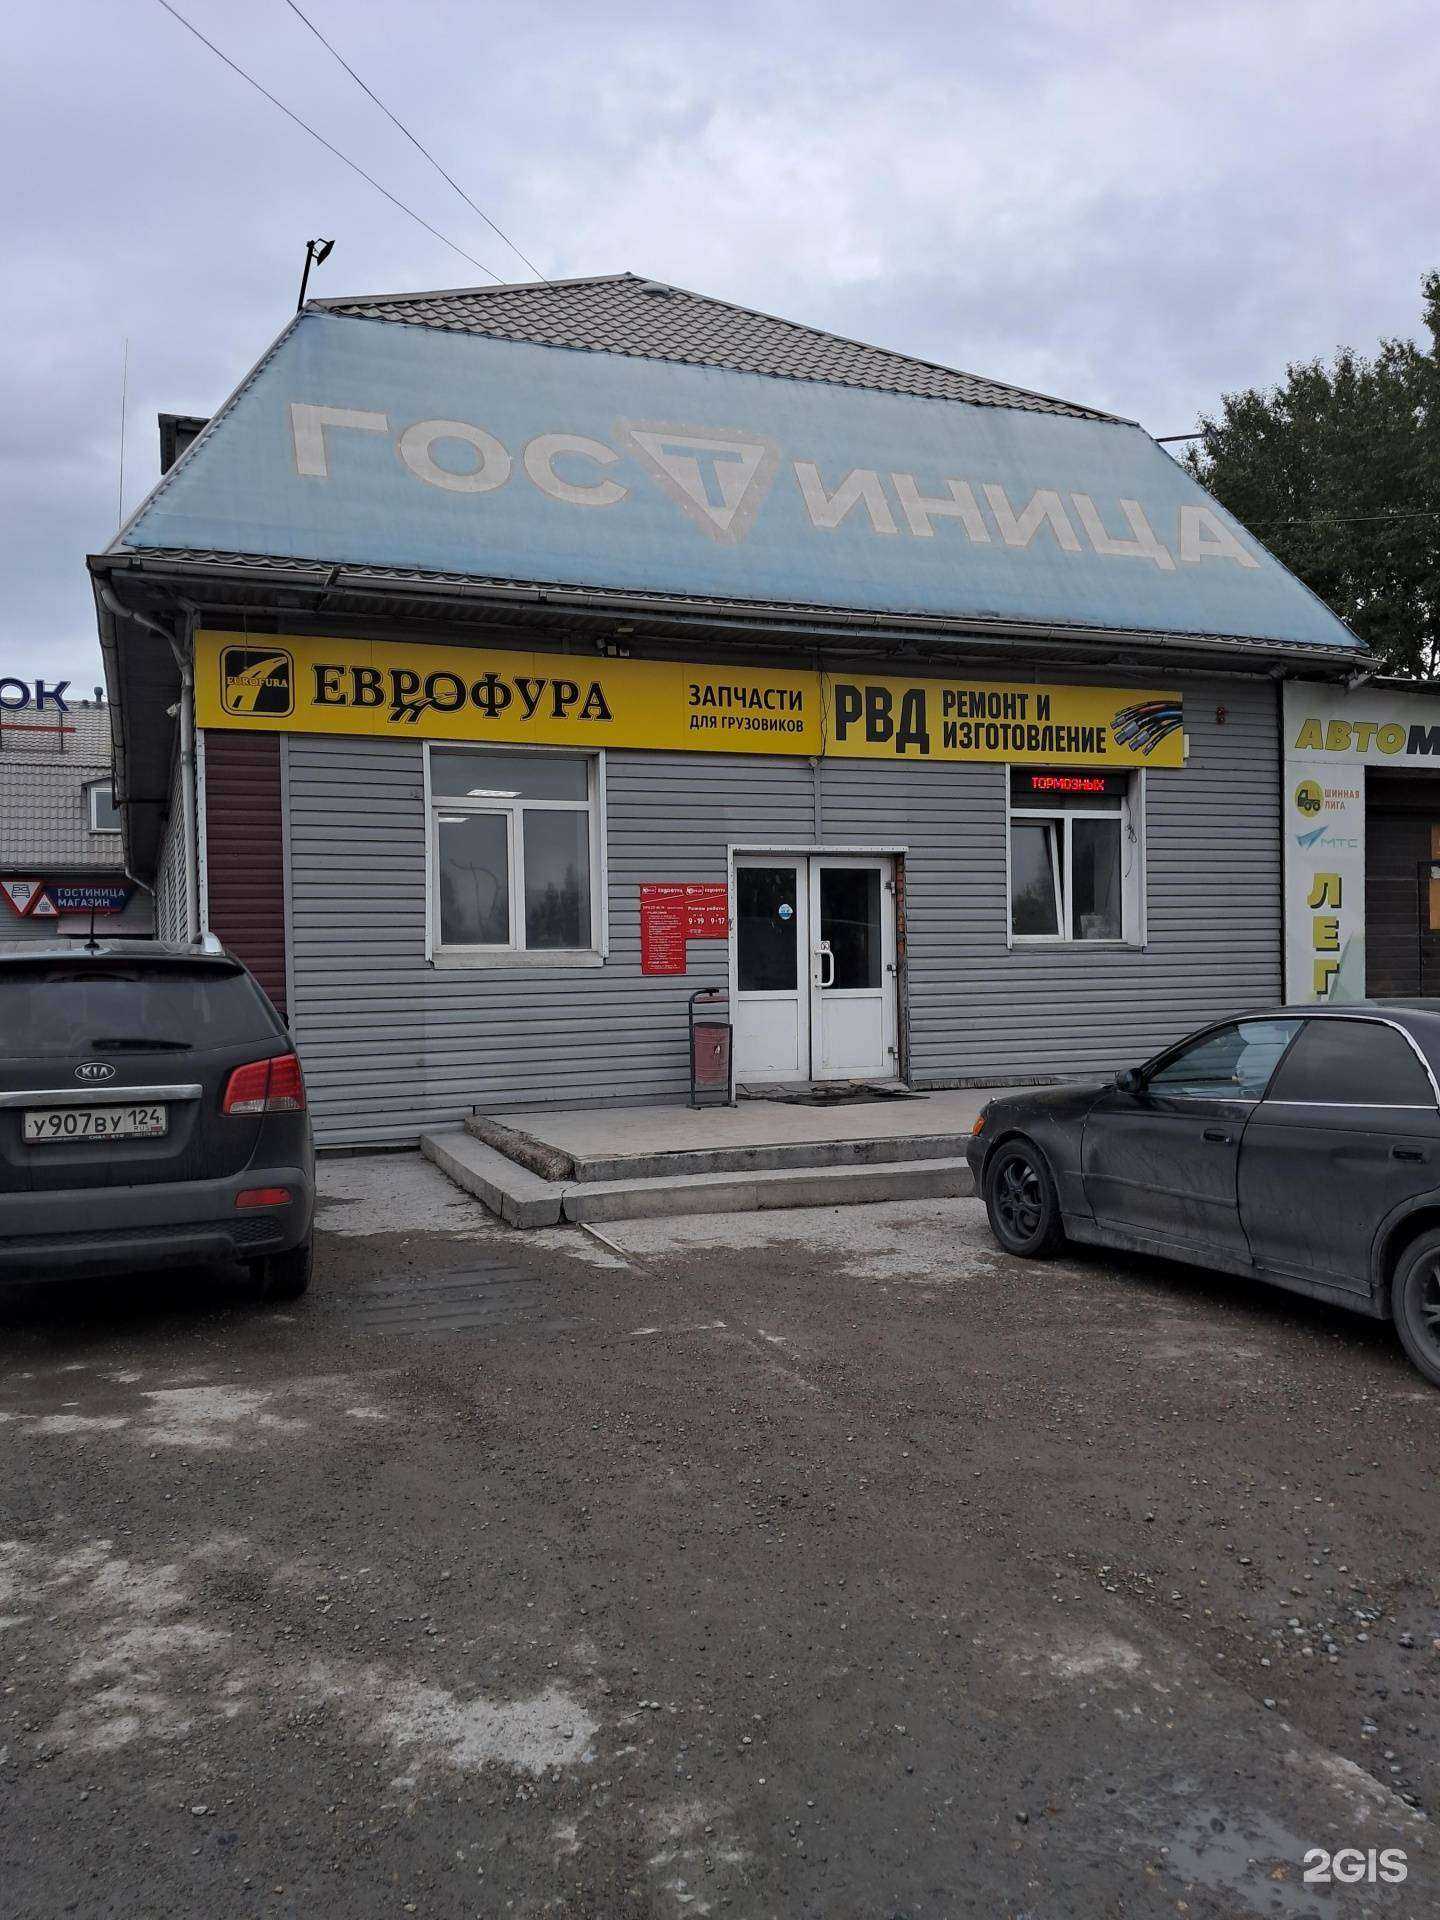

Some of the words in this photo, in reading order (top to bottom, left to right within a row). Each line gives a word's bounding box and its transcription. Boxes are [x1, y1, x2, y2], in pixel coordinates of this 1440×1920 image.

[290, 402, 1261, 571] ГОСТИНИЦА
[226, 676, 288, 688] EUROFURA
[311, 663, 614, 724] ЕВРОФУРА
[688, 683, 804, 712] ЗАПЧАСТИ
[942, 688, 1029, 722] РЕМОНТ
[1037, 693, 1051, 722] И
[689, 714, 718, 731] ДЛЯ
[720, 715, 804, 733] ГРУЗОВИКОВ
[834, 684, 930, 755] РВД
[942, 721, 1107, 754] ИЗГОТОВЛЕНИЕ
[1031, 776, 1105, 791] ТОРМОЗНЫХ
[1324, 788, 1360, 799] ШИННАЯ
[1324, 800, 1346, 811] ЛИГА
[57, 888, 126, 898] ГОСТИНИЦА
[58, 898, 111, 908] МАГАЗИН
[81, 1066, 109, 1077] KIA
[127, 1109, 160, 1125] 124
